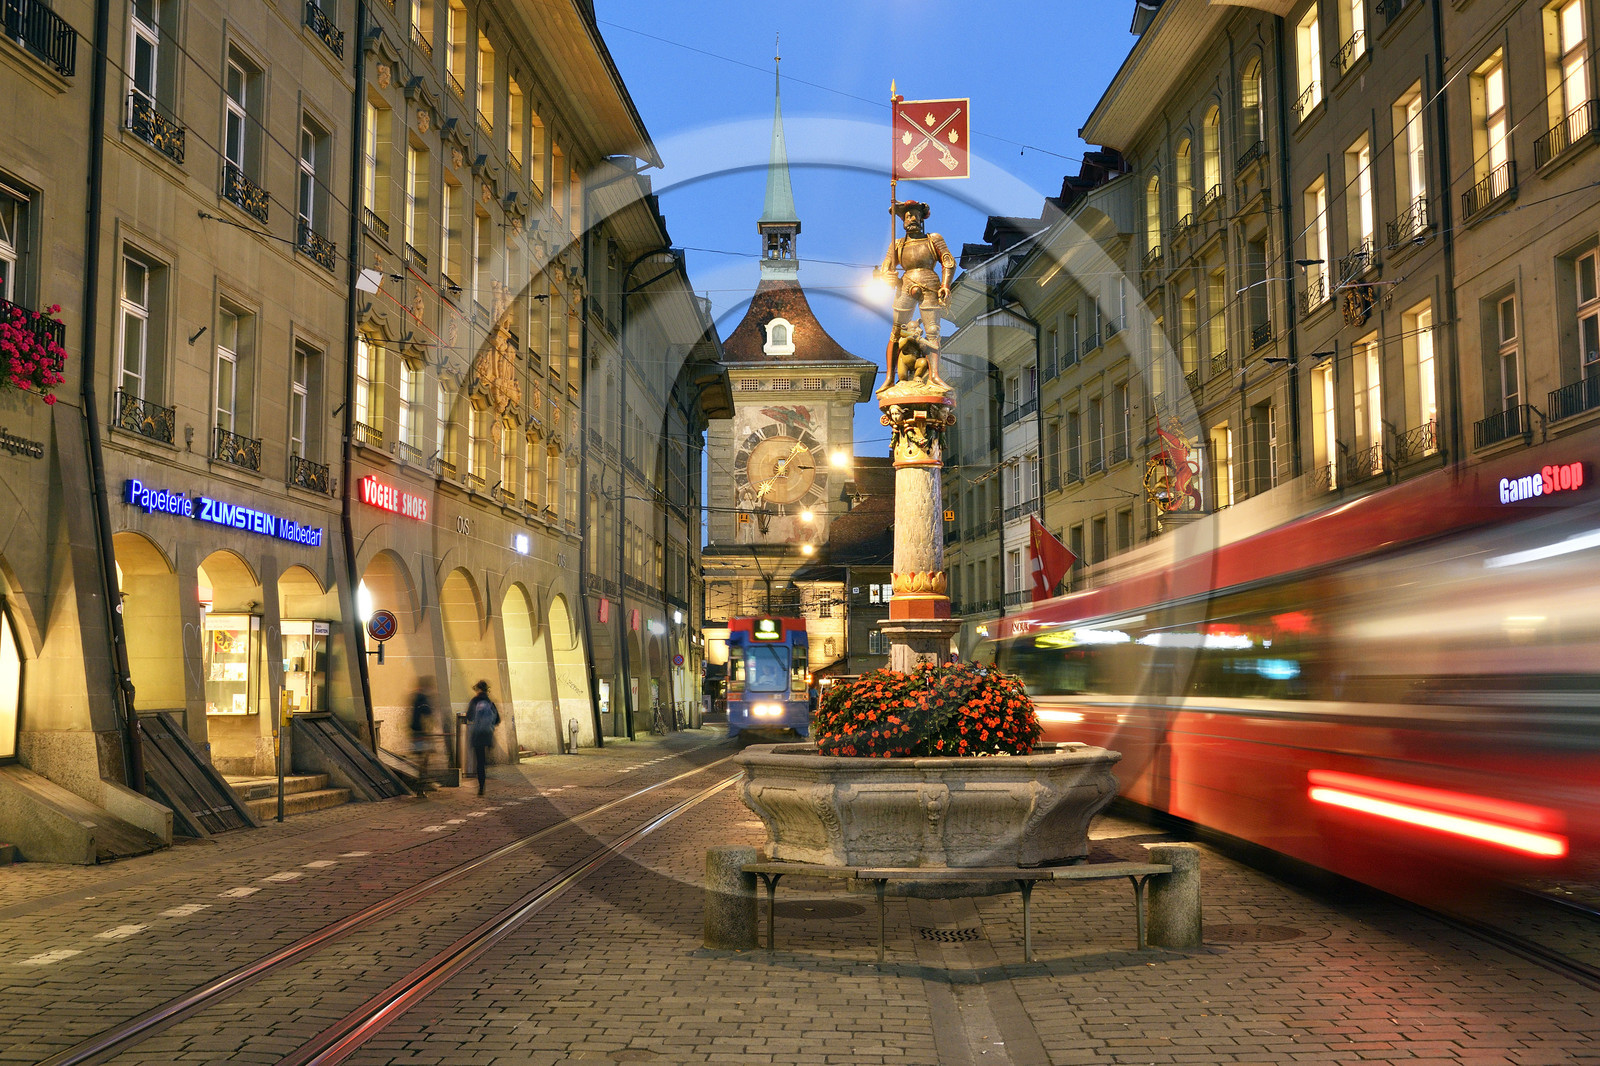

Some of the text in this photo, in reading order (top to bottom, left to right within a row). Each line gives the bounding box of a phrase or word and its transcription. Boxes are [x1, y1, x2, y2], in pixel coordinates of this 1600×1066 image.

[363, 475, 428, 520] VÖGELE SHOES
[1500, 462, 1583, 505] GameStop
[131, 479, 323, 548] Papeterie ZUMSTEIN Malbedarf
